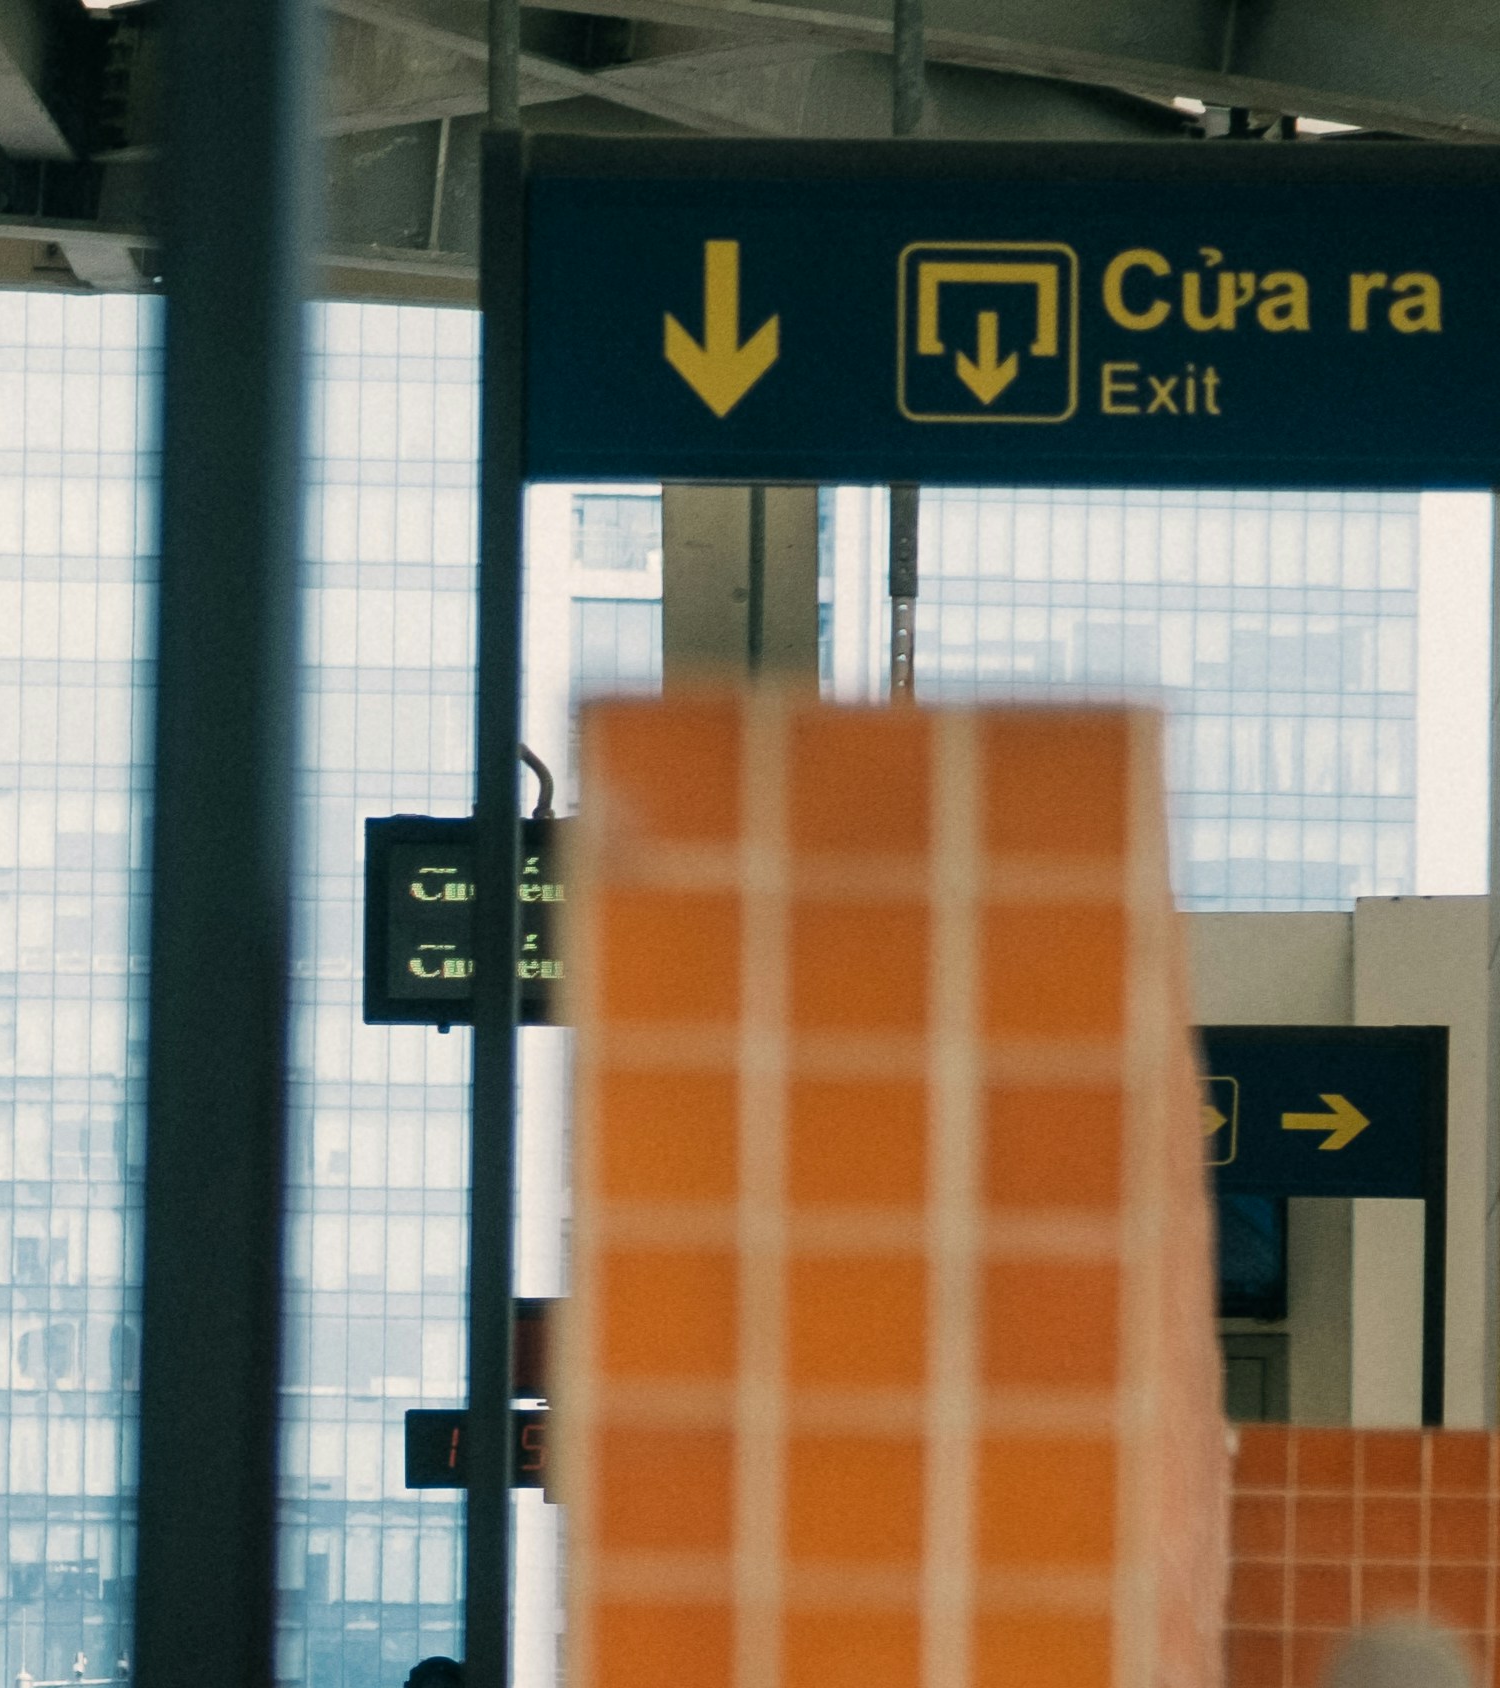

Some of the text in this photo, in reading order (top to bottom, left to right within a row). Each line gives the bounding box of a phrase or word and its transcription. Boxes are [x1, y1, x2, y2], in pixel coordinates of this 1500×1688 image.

[1103, 247, 1442, 332] Cửa ra
[1102, 362, 1220, 415] Exit
